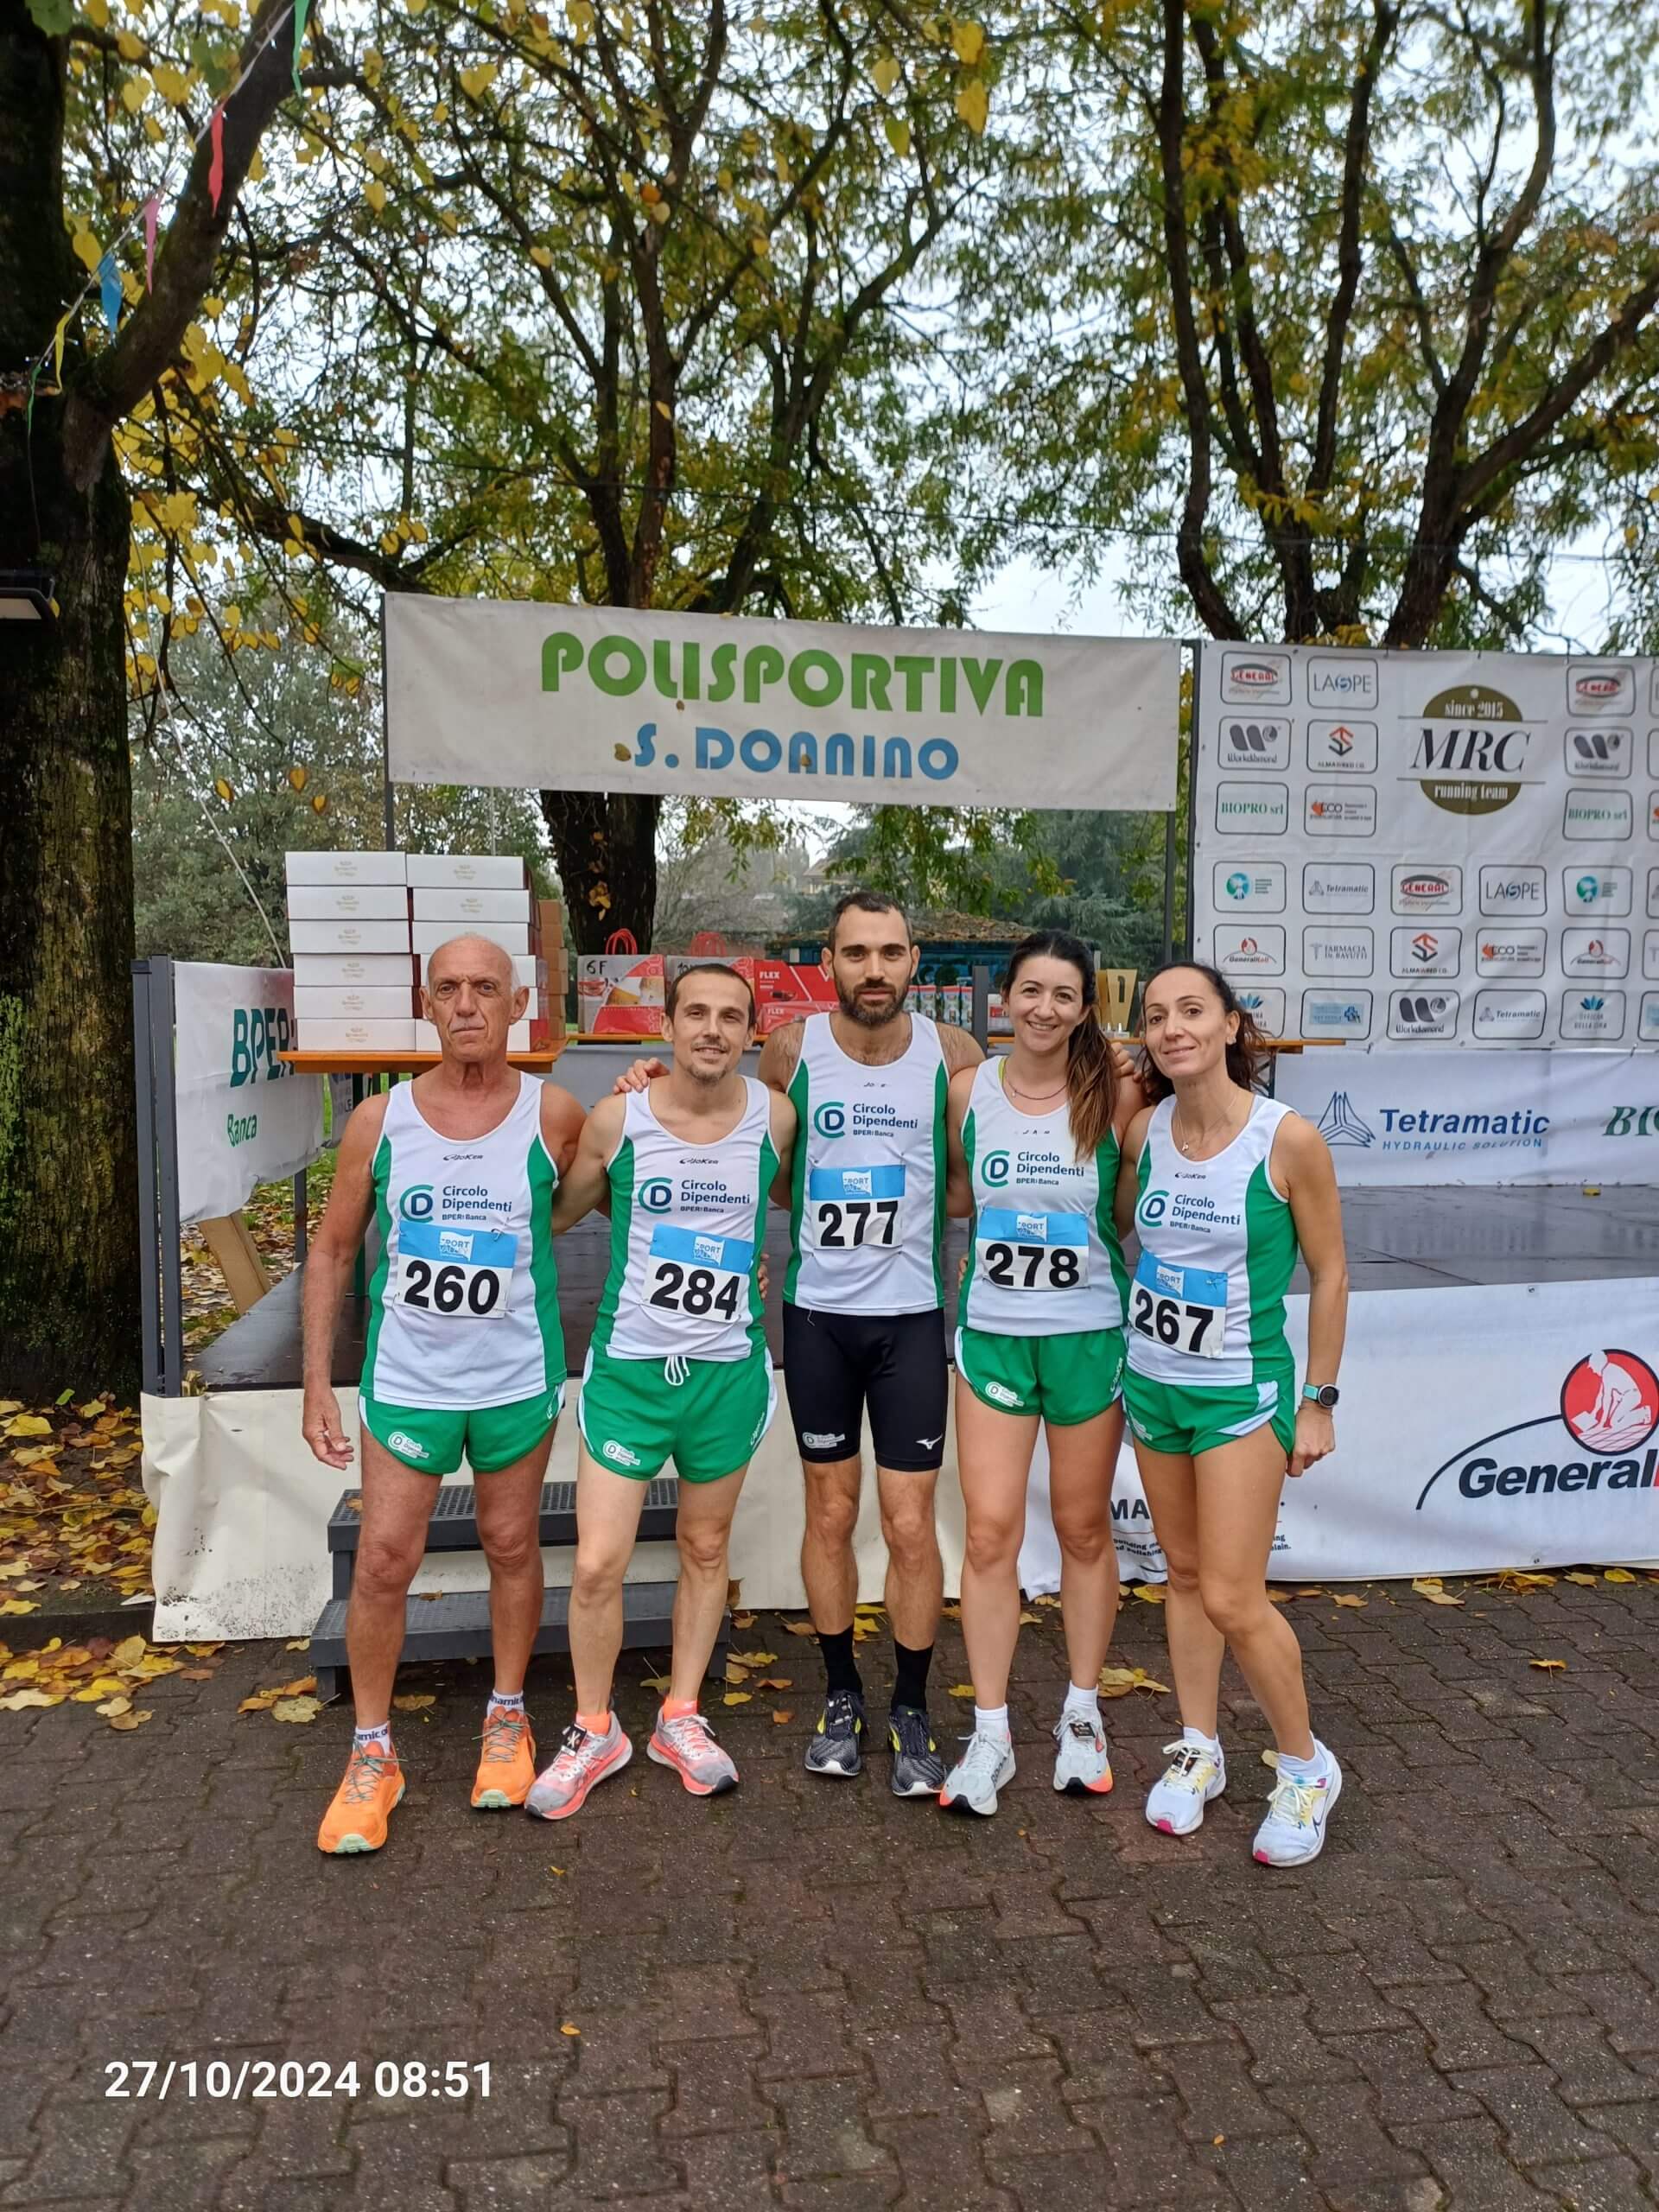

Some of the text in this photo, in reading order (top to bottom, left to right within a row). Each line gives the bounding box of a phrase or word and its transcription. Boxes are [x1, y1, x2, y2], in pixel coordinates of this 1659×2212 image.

[541, 632, 1044, 716] POLISPORTIVA
[1445, 700, 1475, 717] since
[634, 723, 959, 780] S. DONNINO
[1409, 728, 1531, 772] MRC
[1434, 783, 1508, 802] running team
[1221, 802, 1284, 815] BIOPRO srl
[1325, 884, 1369, 893] Tetramatic
[760, 971, 780, 980] FLEX
[1496, 1009, 1541, 1018] Tetramatic
[853, 1103, 895, 1115] Circolo
[853, 1115, 918, 1128] Dipendenti
[1379, 1109, 1551, 1135] Tetramatic
[227, 1114, 257, 1147] Banca
[1382, 1139, 1542, 1151] HYDRAULIC SOLUTION
[1018, 1152, 1060, 1162] Circolo
[1017, 1163, 1084, 1177] Dipendenti
[442, 1185, 488, 1197] Circolo
[681, 1179, 727, 1191] Circolo
[442, 1198, 512, 1212] Dipendenti
[681, 1192, 750, 1205] Dipendenti
[1175, 1194, 1215, 1209] Circolo
[1172, 1205, 1241, 1225] Dipendenti
[818, 1200, 899, 1247] 277
[1191, 1224, 1211, 1233] Banca
[985, 1243, 1079, 1288] 278
[404, 1260, 499, 1315] 260
[650, 1262, 741, 1320] 284
[1135, 1288, 1214, 1353] 267
[1459, 1449, 1659, 1498] General
